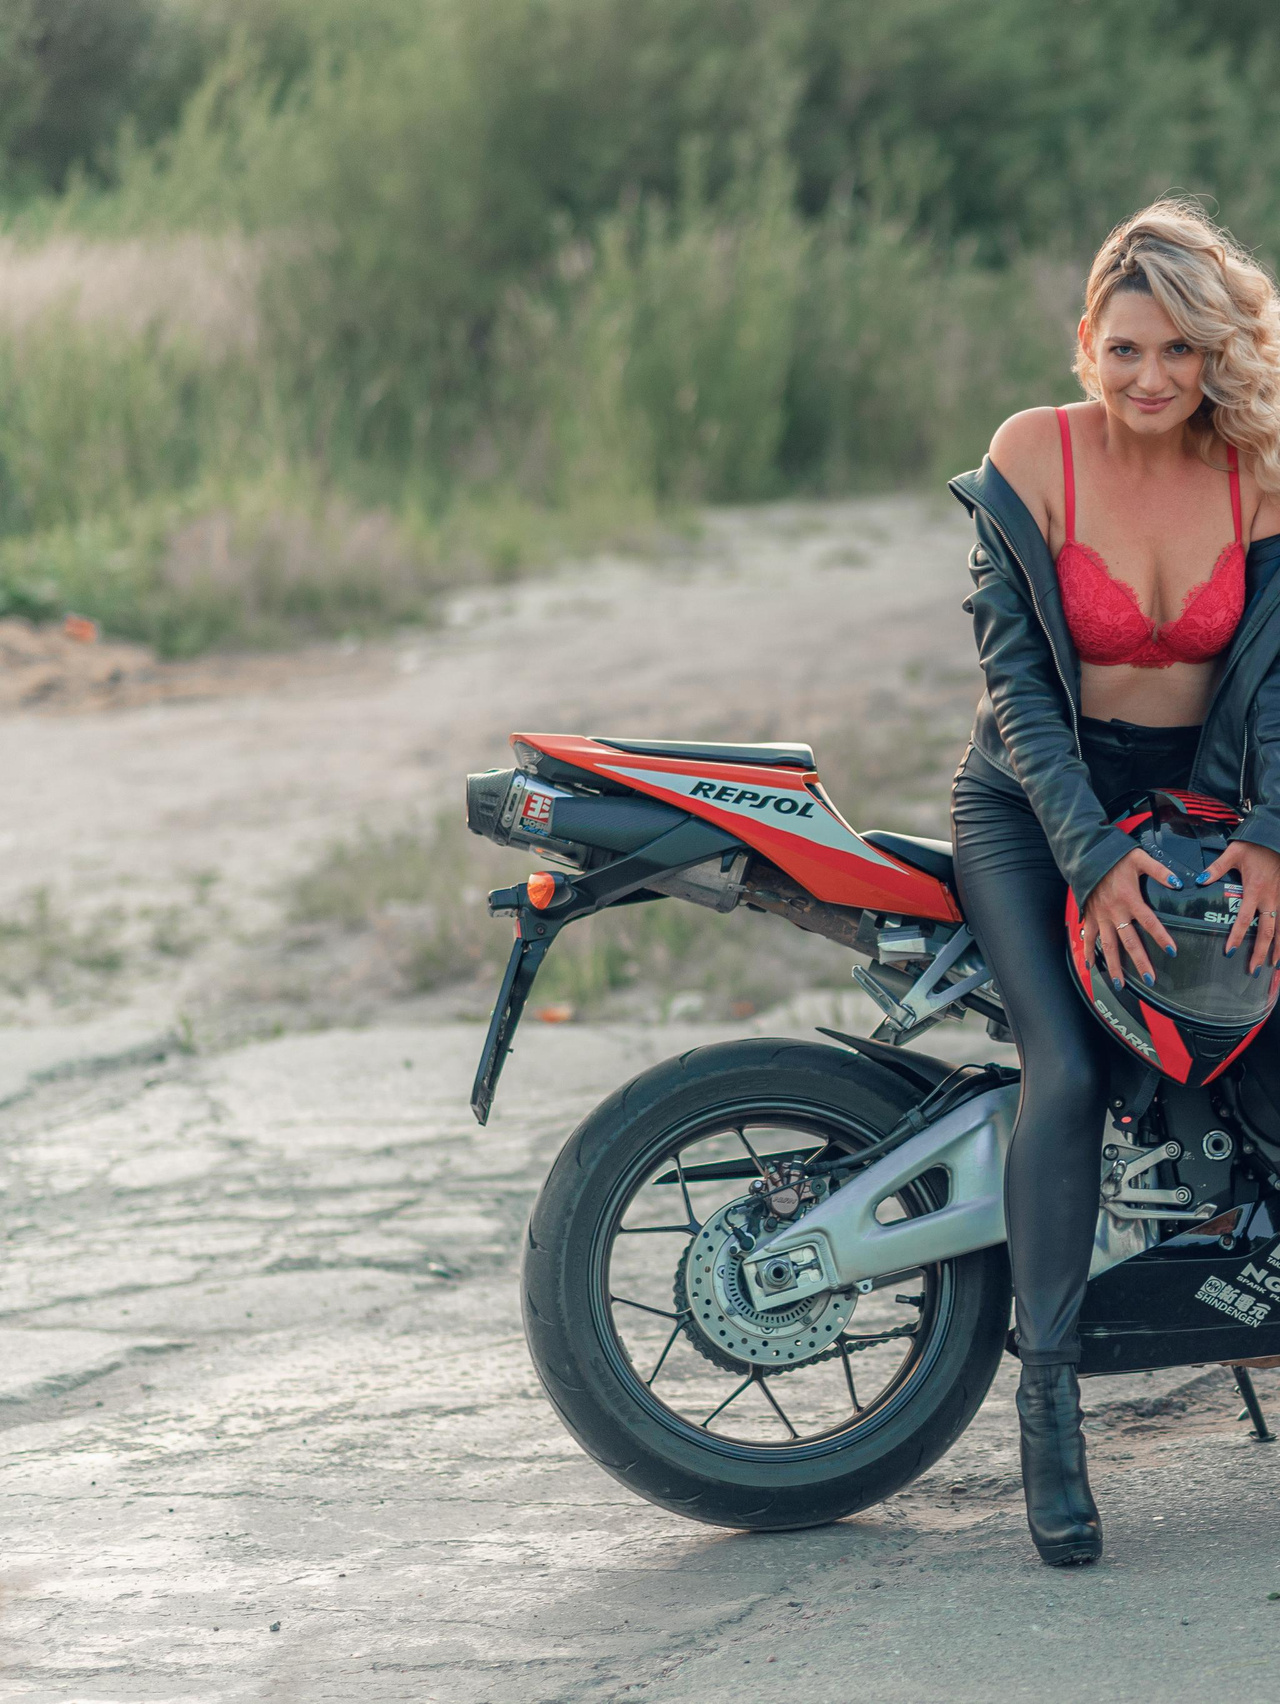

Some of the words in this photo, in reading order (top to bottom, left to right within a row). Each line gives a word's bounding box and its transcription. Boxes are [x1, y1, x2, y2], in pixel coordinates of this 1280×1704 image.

[689, 781, 814, 818] REPSOL
[1094, 999, 1157, 1057] SHARK
[1236, 1275, 1267, 1294] SPARK
[1194, 1290, 1262, 1328] SHINDENGEN
